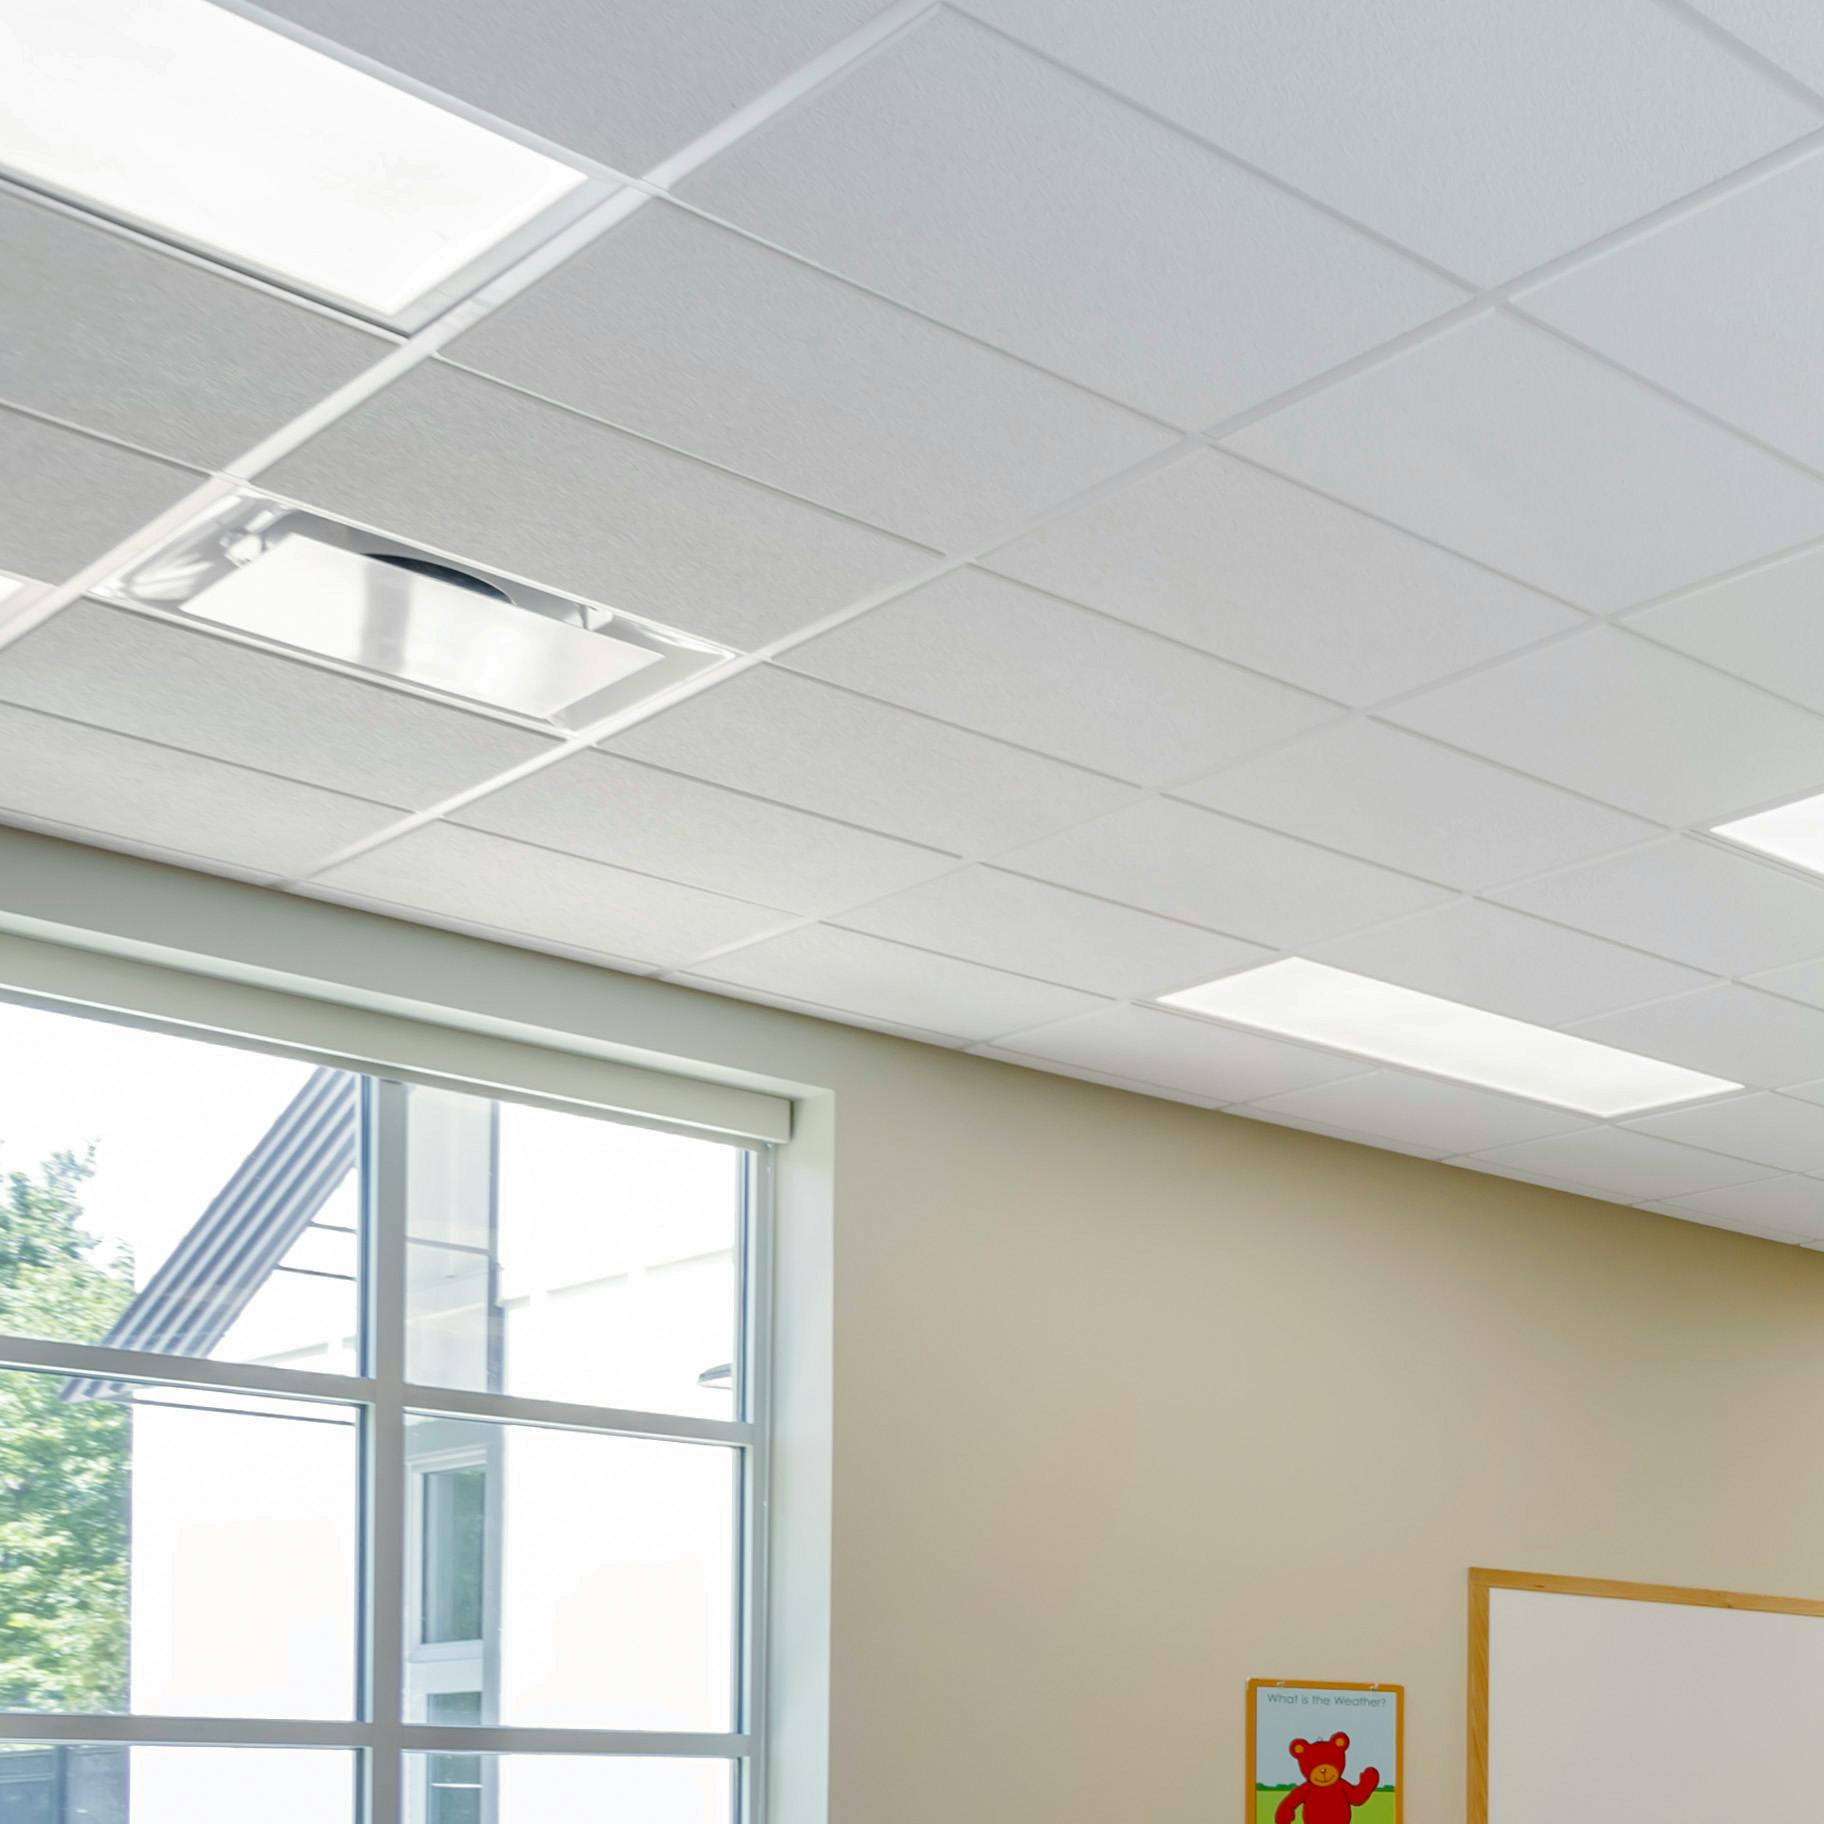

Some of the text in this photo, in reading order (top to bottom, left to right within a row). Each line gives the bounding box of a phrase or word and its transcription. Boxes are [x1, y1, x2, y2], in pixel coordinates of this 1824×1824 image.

[1267, 1693, 1386, 1708] What is the Weather?
